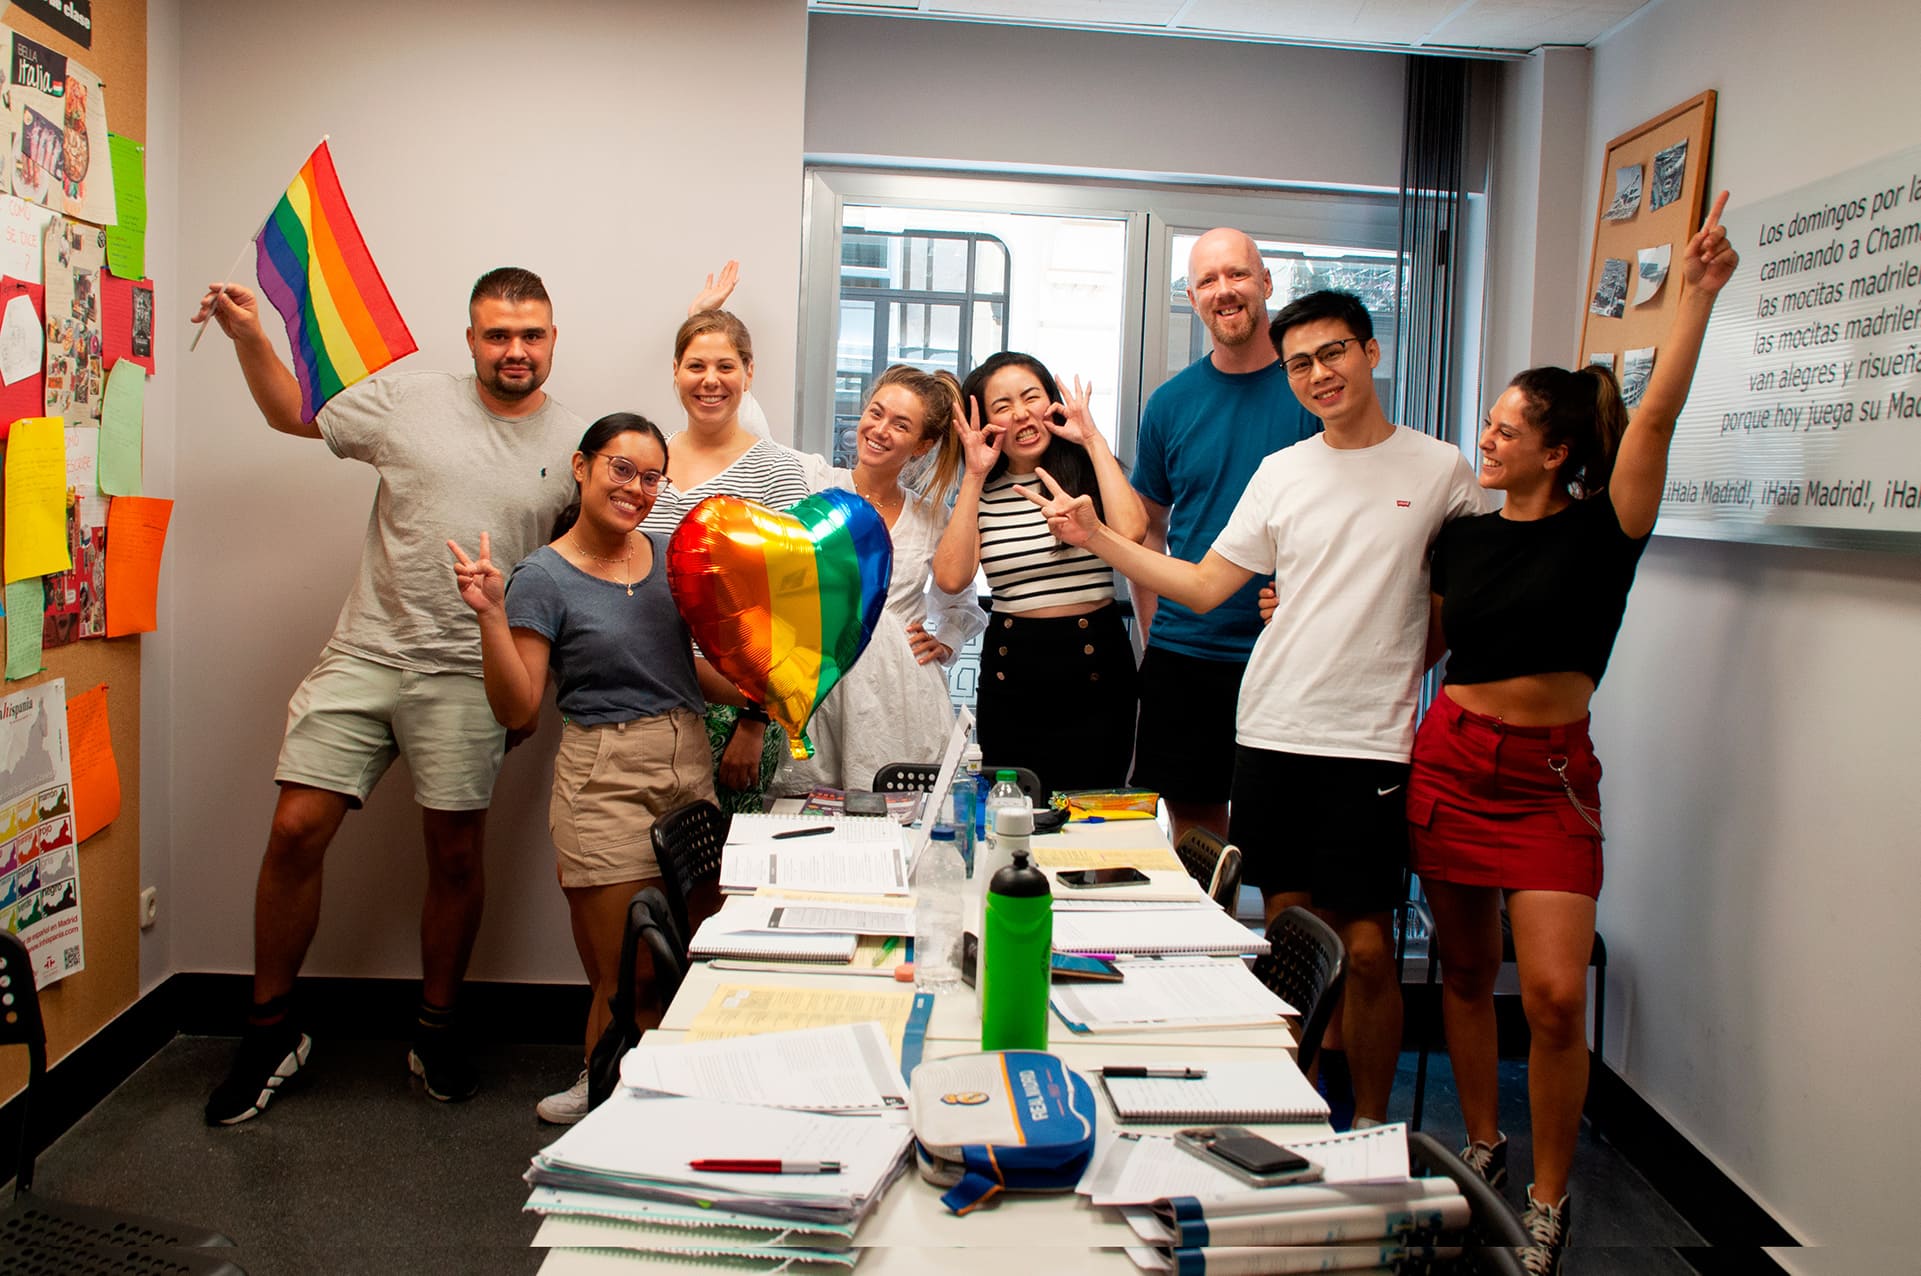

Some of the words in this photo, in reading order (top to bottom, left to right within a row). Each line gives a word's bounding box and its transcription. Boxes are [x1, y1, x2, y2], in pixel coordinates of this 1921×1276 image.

[17, 43, 38, 62] BELLA
[18, 58, 53, 93] Italia
[1759, 223, 1784, 246] Los
[1788, 197, 1867, 231] domingos
[1871, 185, 1905, 220] por
[1760, 239, 1844, 281] caminando
[1849, 239, 1860, 259] a
[1866, 222, 1921, 255] Cham
[1757, 294, 1778, 319] las
[1782, 282, 1844, 313] mocitas
[1849, 260, 1921, 300] madrile
[1753, 331, 1775, 355] las
[1778, 321, 1840, 351] mocitas
[1750, 370, 1775, 392] van
[1778, 361, 1837, 392] alegres
[1841, 360, 1853, 388] y
[1721, 409, 1770, 437] porque
[1774, 403, 1802, 432] hoy
[1804, 400, 1853, 432] juega
[1859, 399, 1881, 421] su
[1701, 479, 1754, 509] Madrid!,
[1761, 480, 1800, 506] ¡Hala
[1805, 479, 1875, 514] Madrid!,
